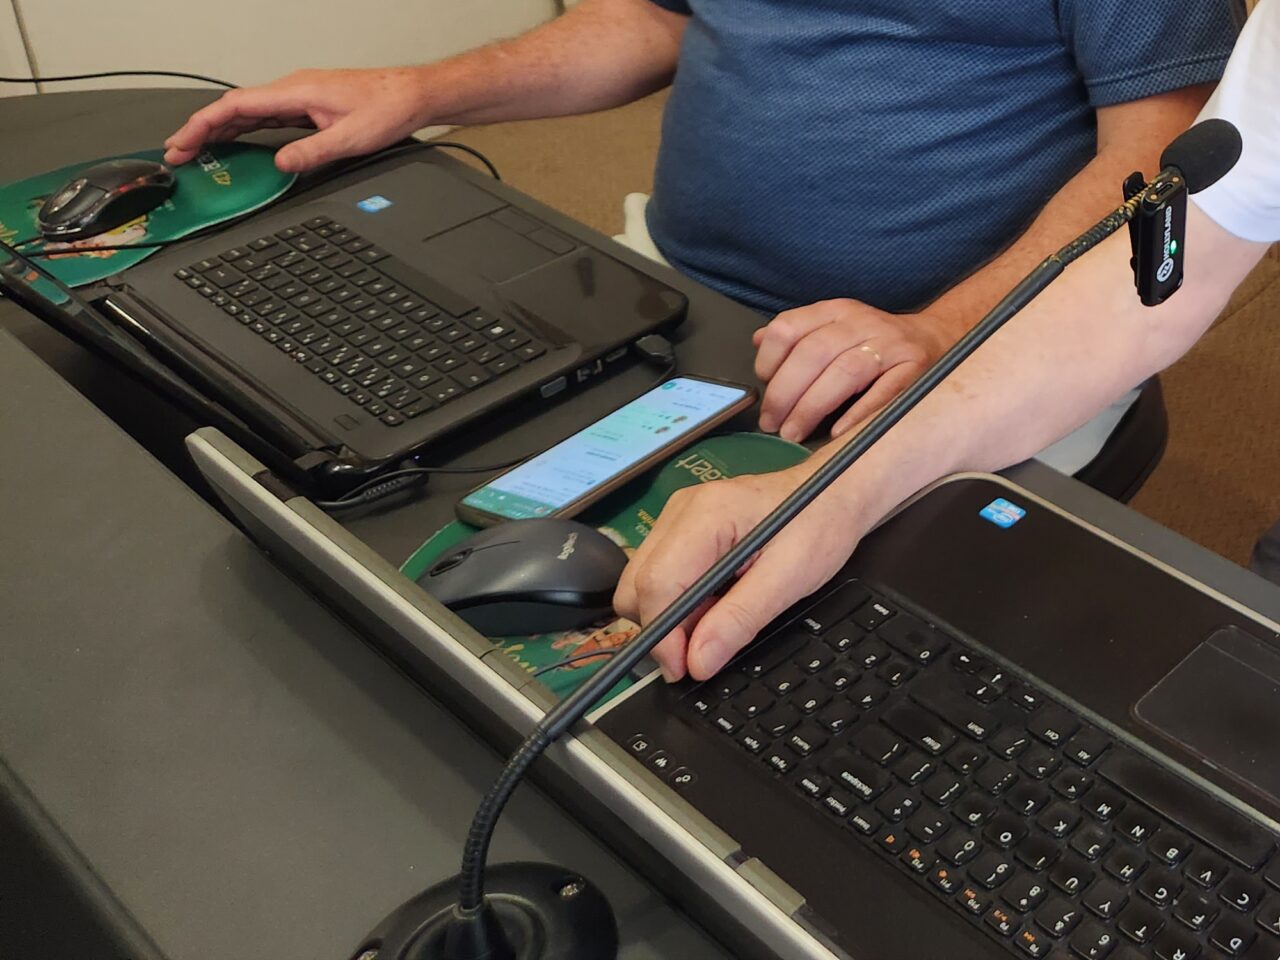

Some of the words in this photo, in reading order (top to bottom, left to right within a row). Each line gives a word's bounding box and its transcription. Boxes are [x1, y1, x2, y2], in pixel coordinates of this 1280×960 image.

[1162, 205, 1172, 260] HOLLYLAND
[675, 453, 731, 482] aert
[1045, 729, 1059, 740] Ctrl
